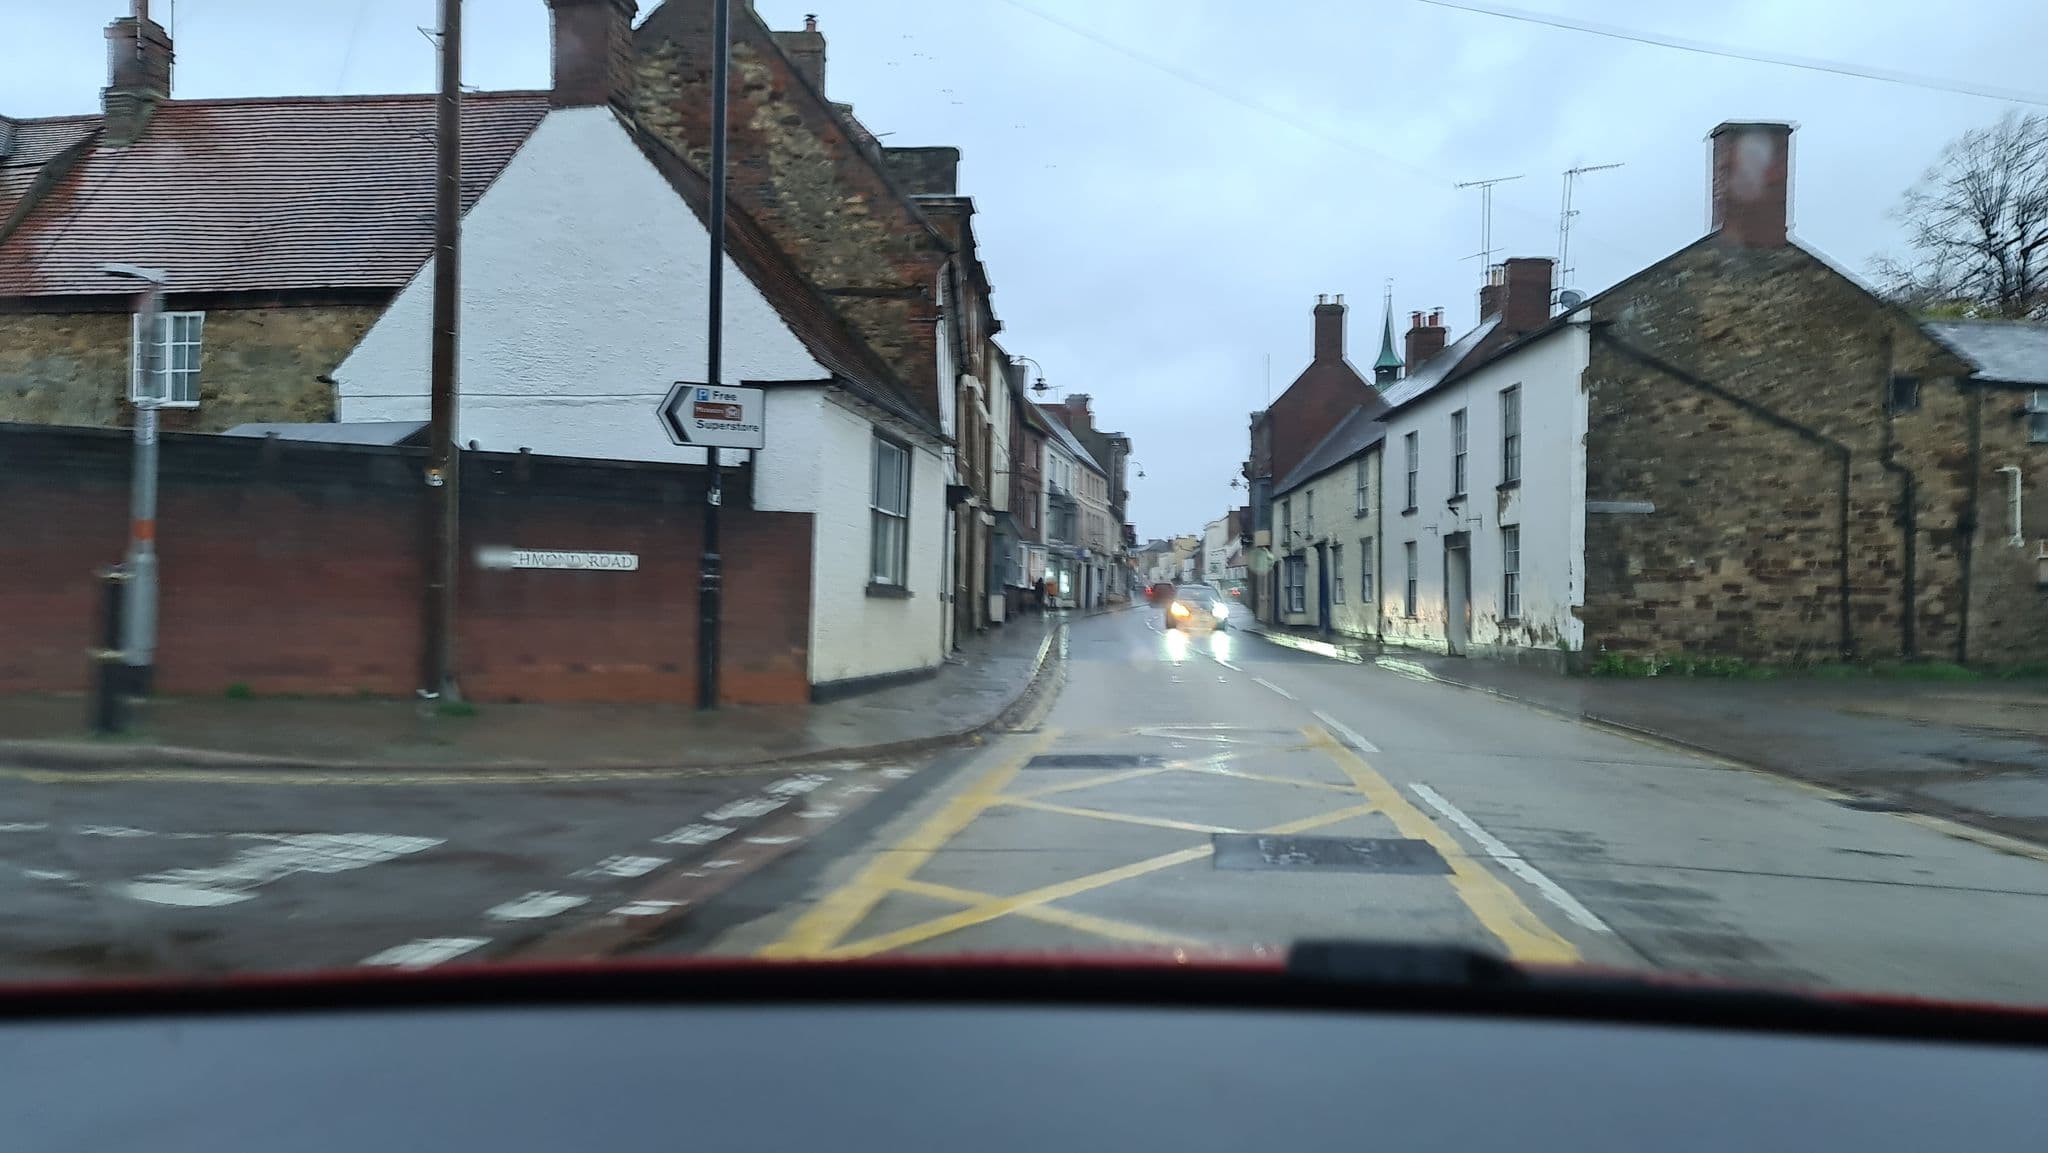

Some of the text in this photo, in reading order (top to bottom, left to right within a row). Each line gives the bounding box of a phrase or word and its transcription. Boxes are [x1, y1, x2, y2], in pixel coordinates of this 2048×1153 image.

[712, 390, 737, 401] Free
[695, 419, 760, 432] Superstore
[499, 552, 633, 568] HMOND ROAD
